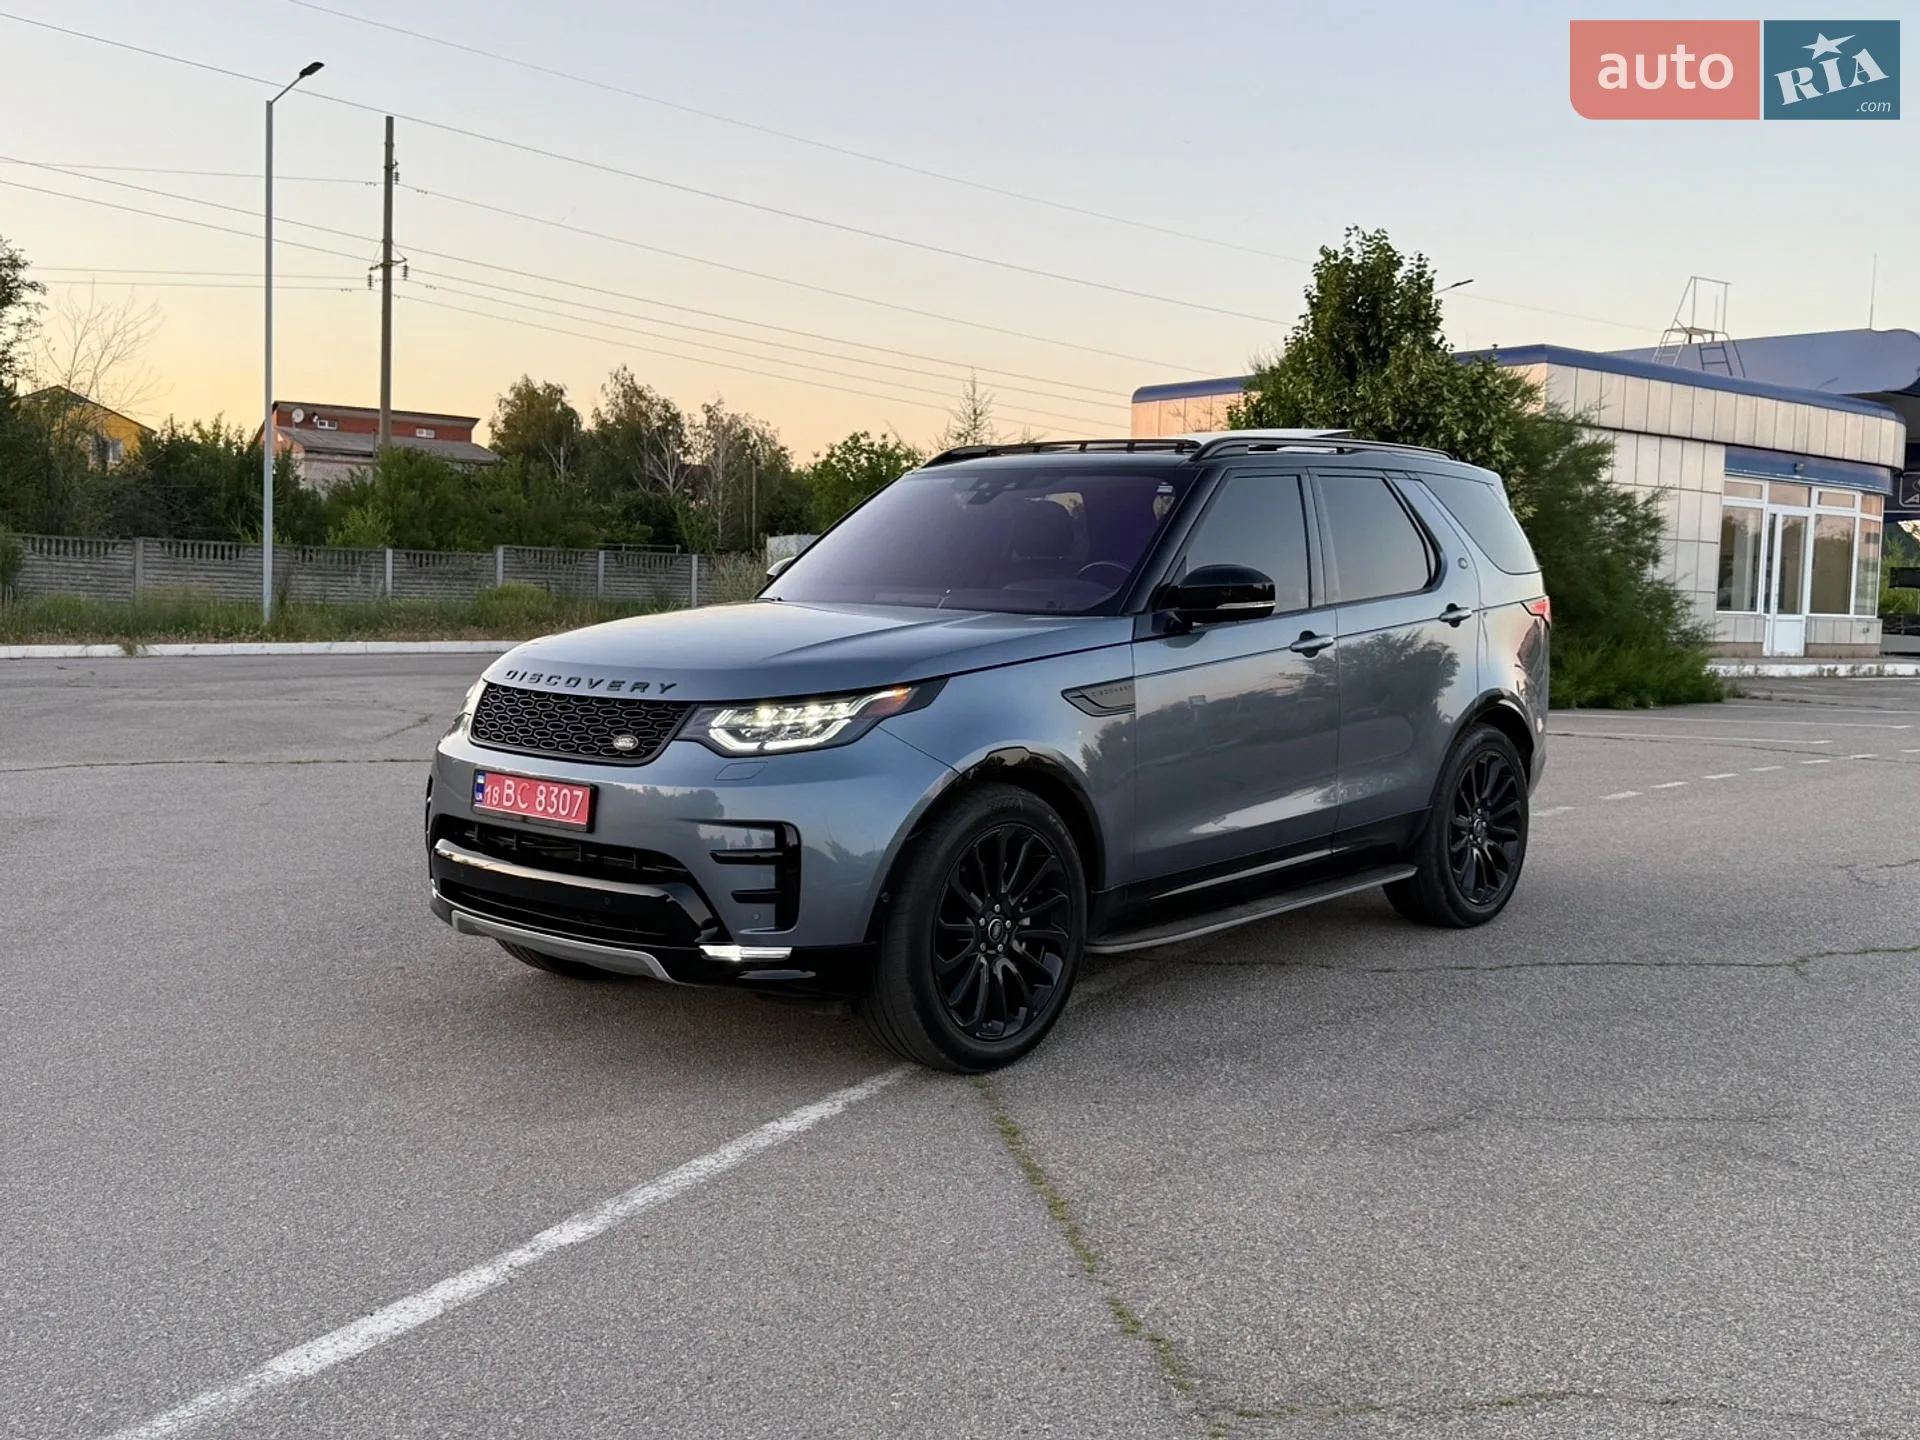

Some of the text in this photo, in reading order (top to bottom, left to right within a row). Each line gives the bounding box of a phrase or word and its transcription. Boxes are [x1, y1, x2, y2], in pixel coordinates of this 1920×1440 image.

[504, 669, 677, 695] DISCOVERY
[484, 779, 583, 818] 18 BC 8307
